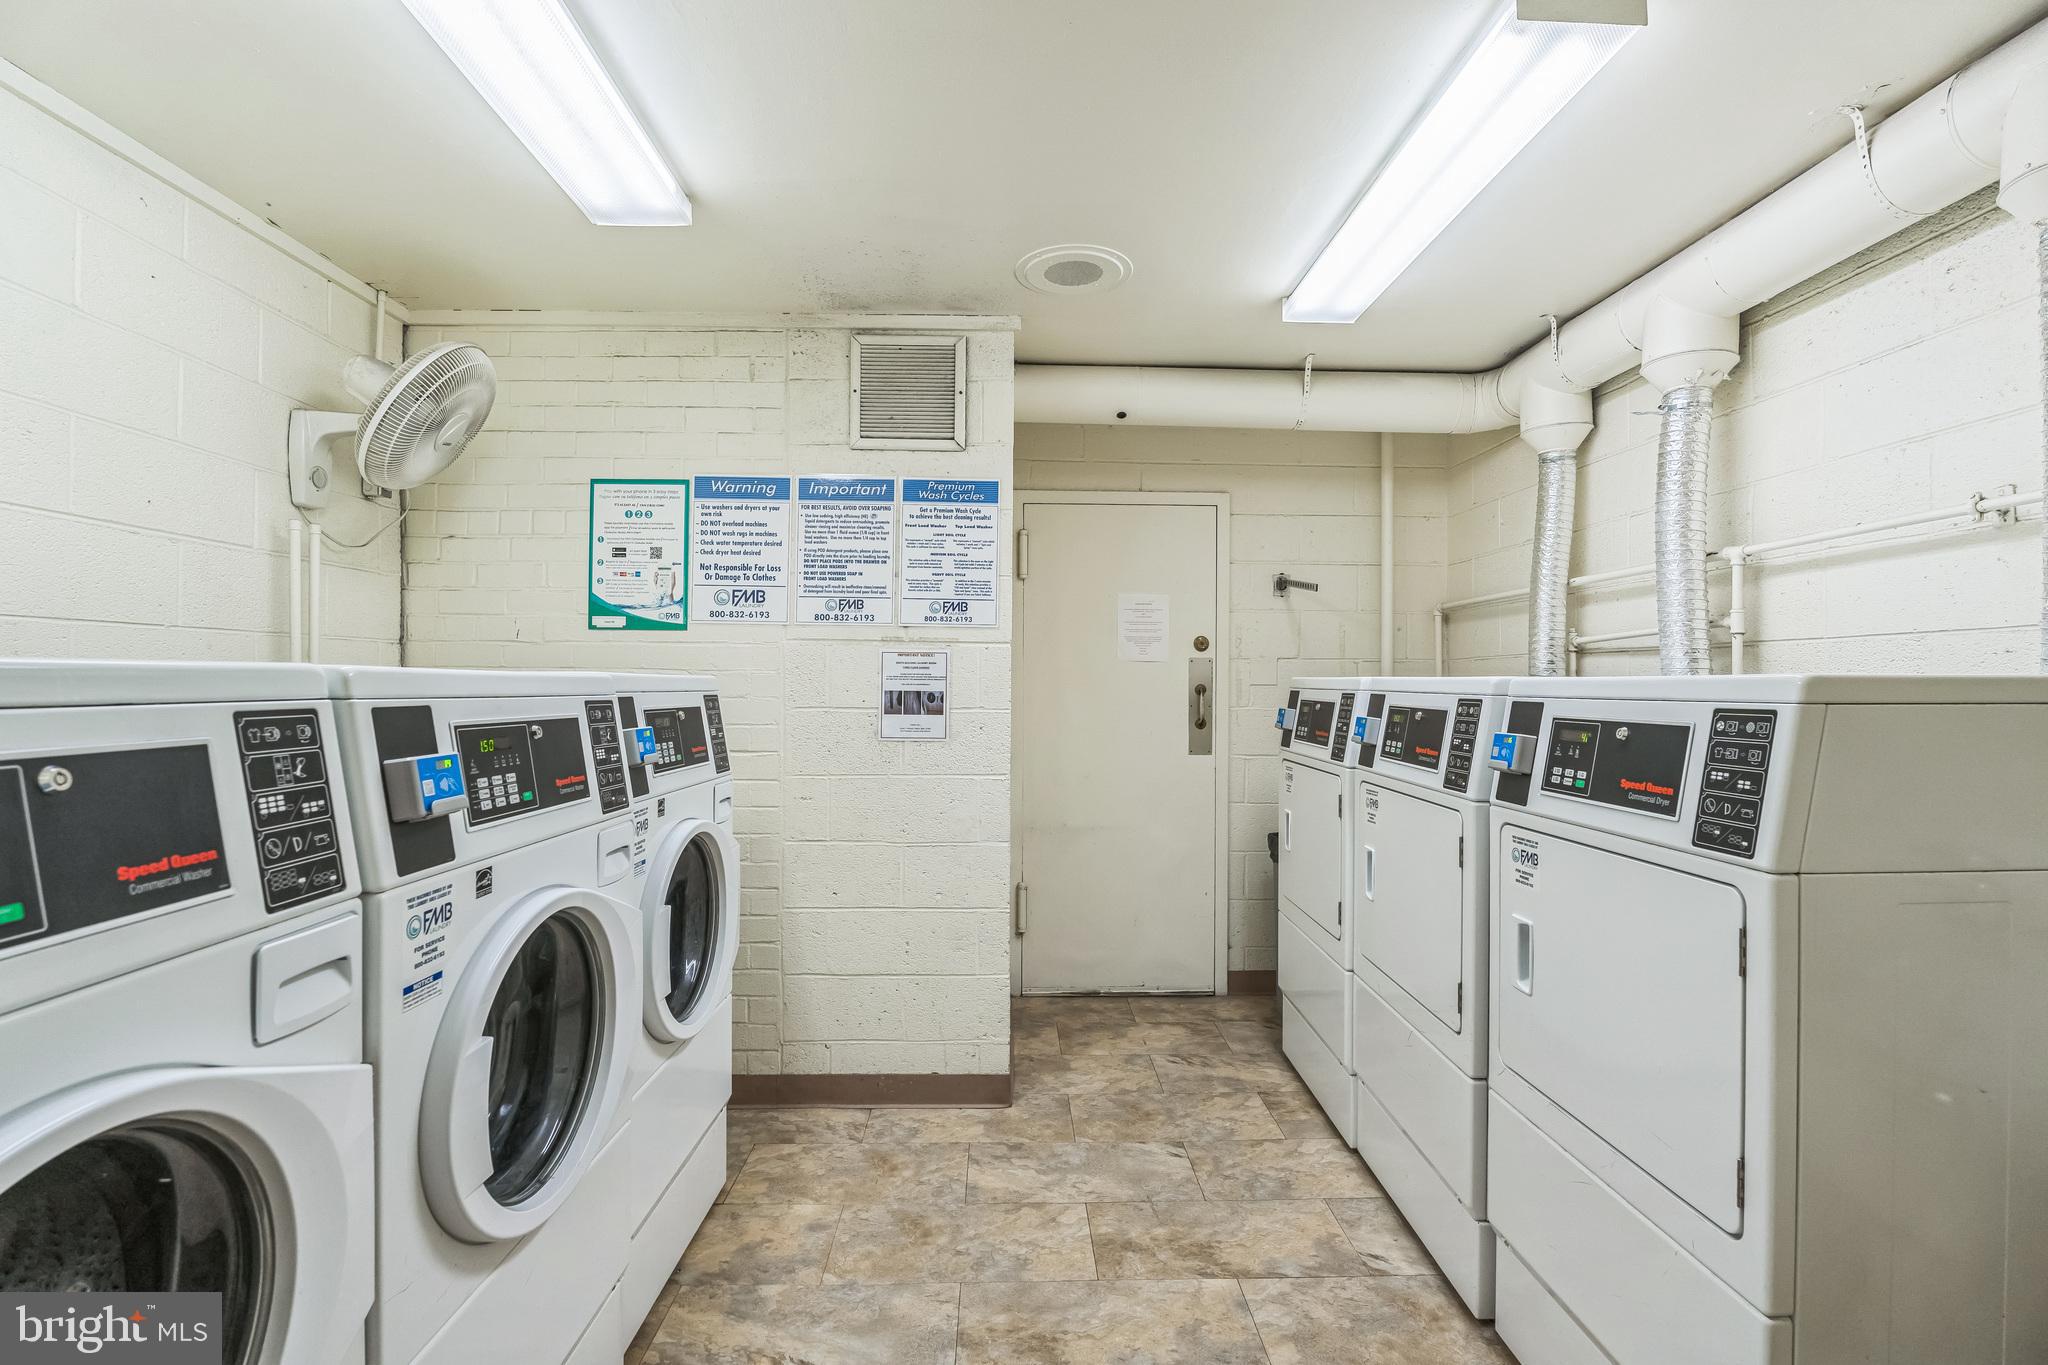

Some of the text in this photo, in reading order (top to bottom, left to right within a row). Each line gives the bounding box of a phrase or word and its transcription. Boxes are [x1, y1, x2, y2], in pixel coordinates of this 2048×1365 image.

[712, 480, 776, 496] Warning
[809, 482, 887, 497] Important
[928, 482, 975, 491] Premium
[919, 491, 984, 502] Wash Cycles
[714, 563, 752, 572] Responsible
[715, 573, 741, 582] Damage
[732, 590, 766, 607] FMB
[839, 599, 864, 612] FMB
[943, 602, 968, 614] FMB
[556, 776, 570, 787] Speed
[1620, 779, 1673, 795] Speed Queen
[1628, 792, 1670, 806] Commercial Dryer
[1521, 850, 1538, 865] FMB
[117, 849, 218, 881] Speed Queen
[129, 868, 213, 895] Commercial Washer
[424, 902, 452, 935] FMB
[414, 936, 445, 953] FOR SERVICE
[422, 946, 438, 958] PHONE
[413, 976, 433, 990] NOTICE
